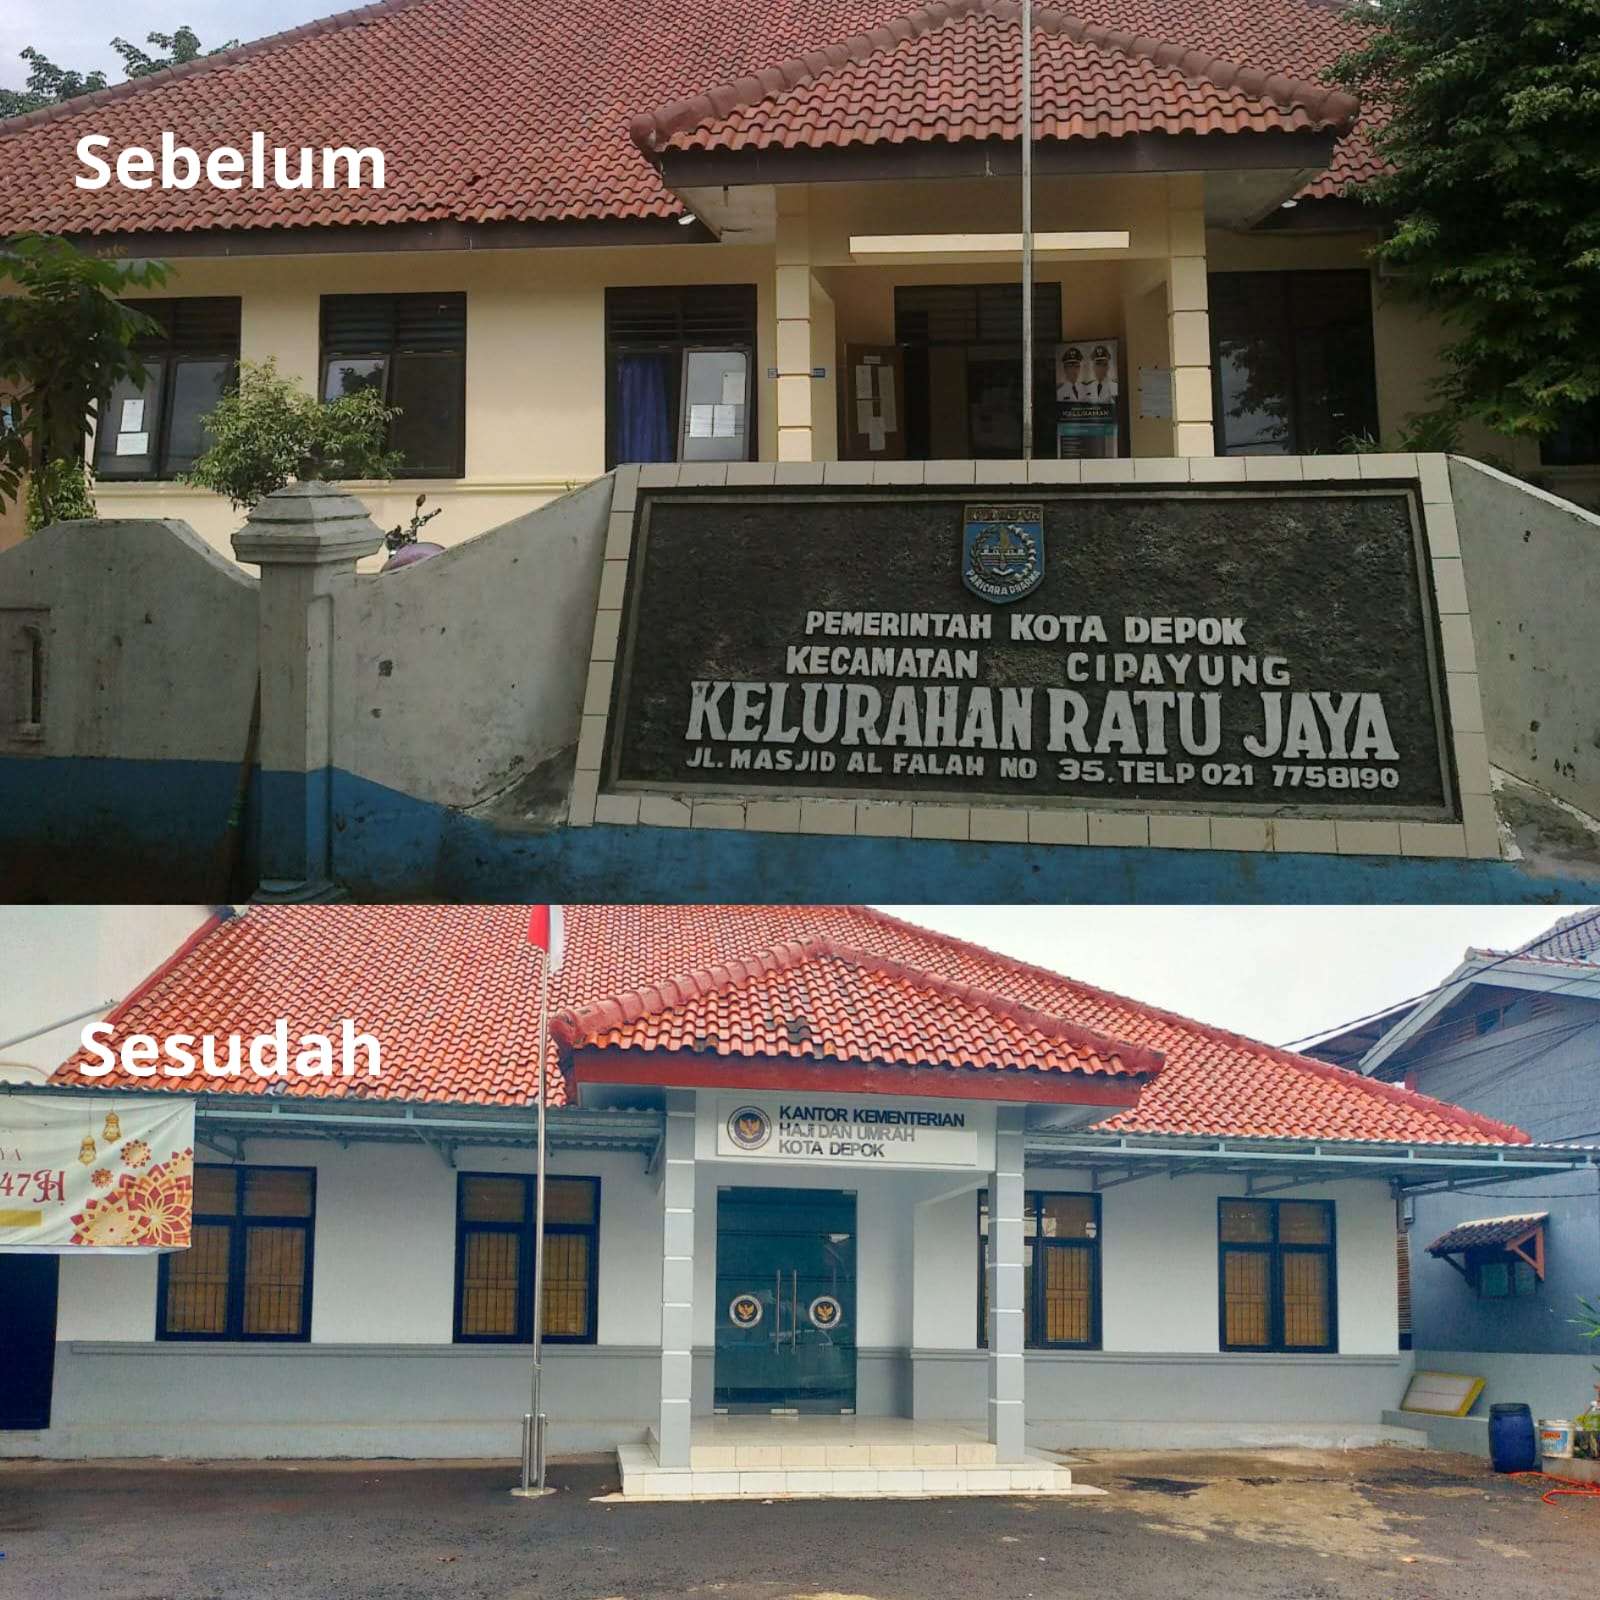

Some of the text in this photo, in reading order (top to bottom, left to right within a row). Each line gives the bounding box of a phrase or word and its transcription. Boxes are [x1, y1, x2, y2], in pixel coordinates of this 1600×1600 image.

[805, 610, 1247, 646] PEMERINTAH KOTA DEPOK
[786, 645, 1291, 688] KECAMATAN CIPAYUNG
[685, 680, 1400, 761] KELURAHAN RATU JAYA
[686, 746, 724, 769] JL.
[729, 748, 836, 772] MASJID
[846, 751, 883, 774] AL
[892, 752, 985, 777] FALAH
[999, 757, 1038, 779] NO
[1201, 763, 1255, 786] 021
[1271, 764, 1400, 789] 7758190
[779, 1105, 965, 1127] KANTOR KEMENTERIAN
[818, 1123, 852, 1139] DAN
[856, 1126, 916, 1142] UMRAH
[778, 1139, 885, 1158] KOTA DEPOK
